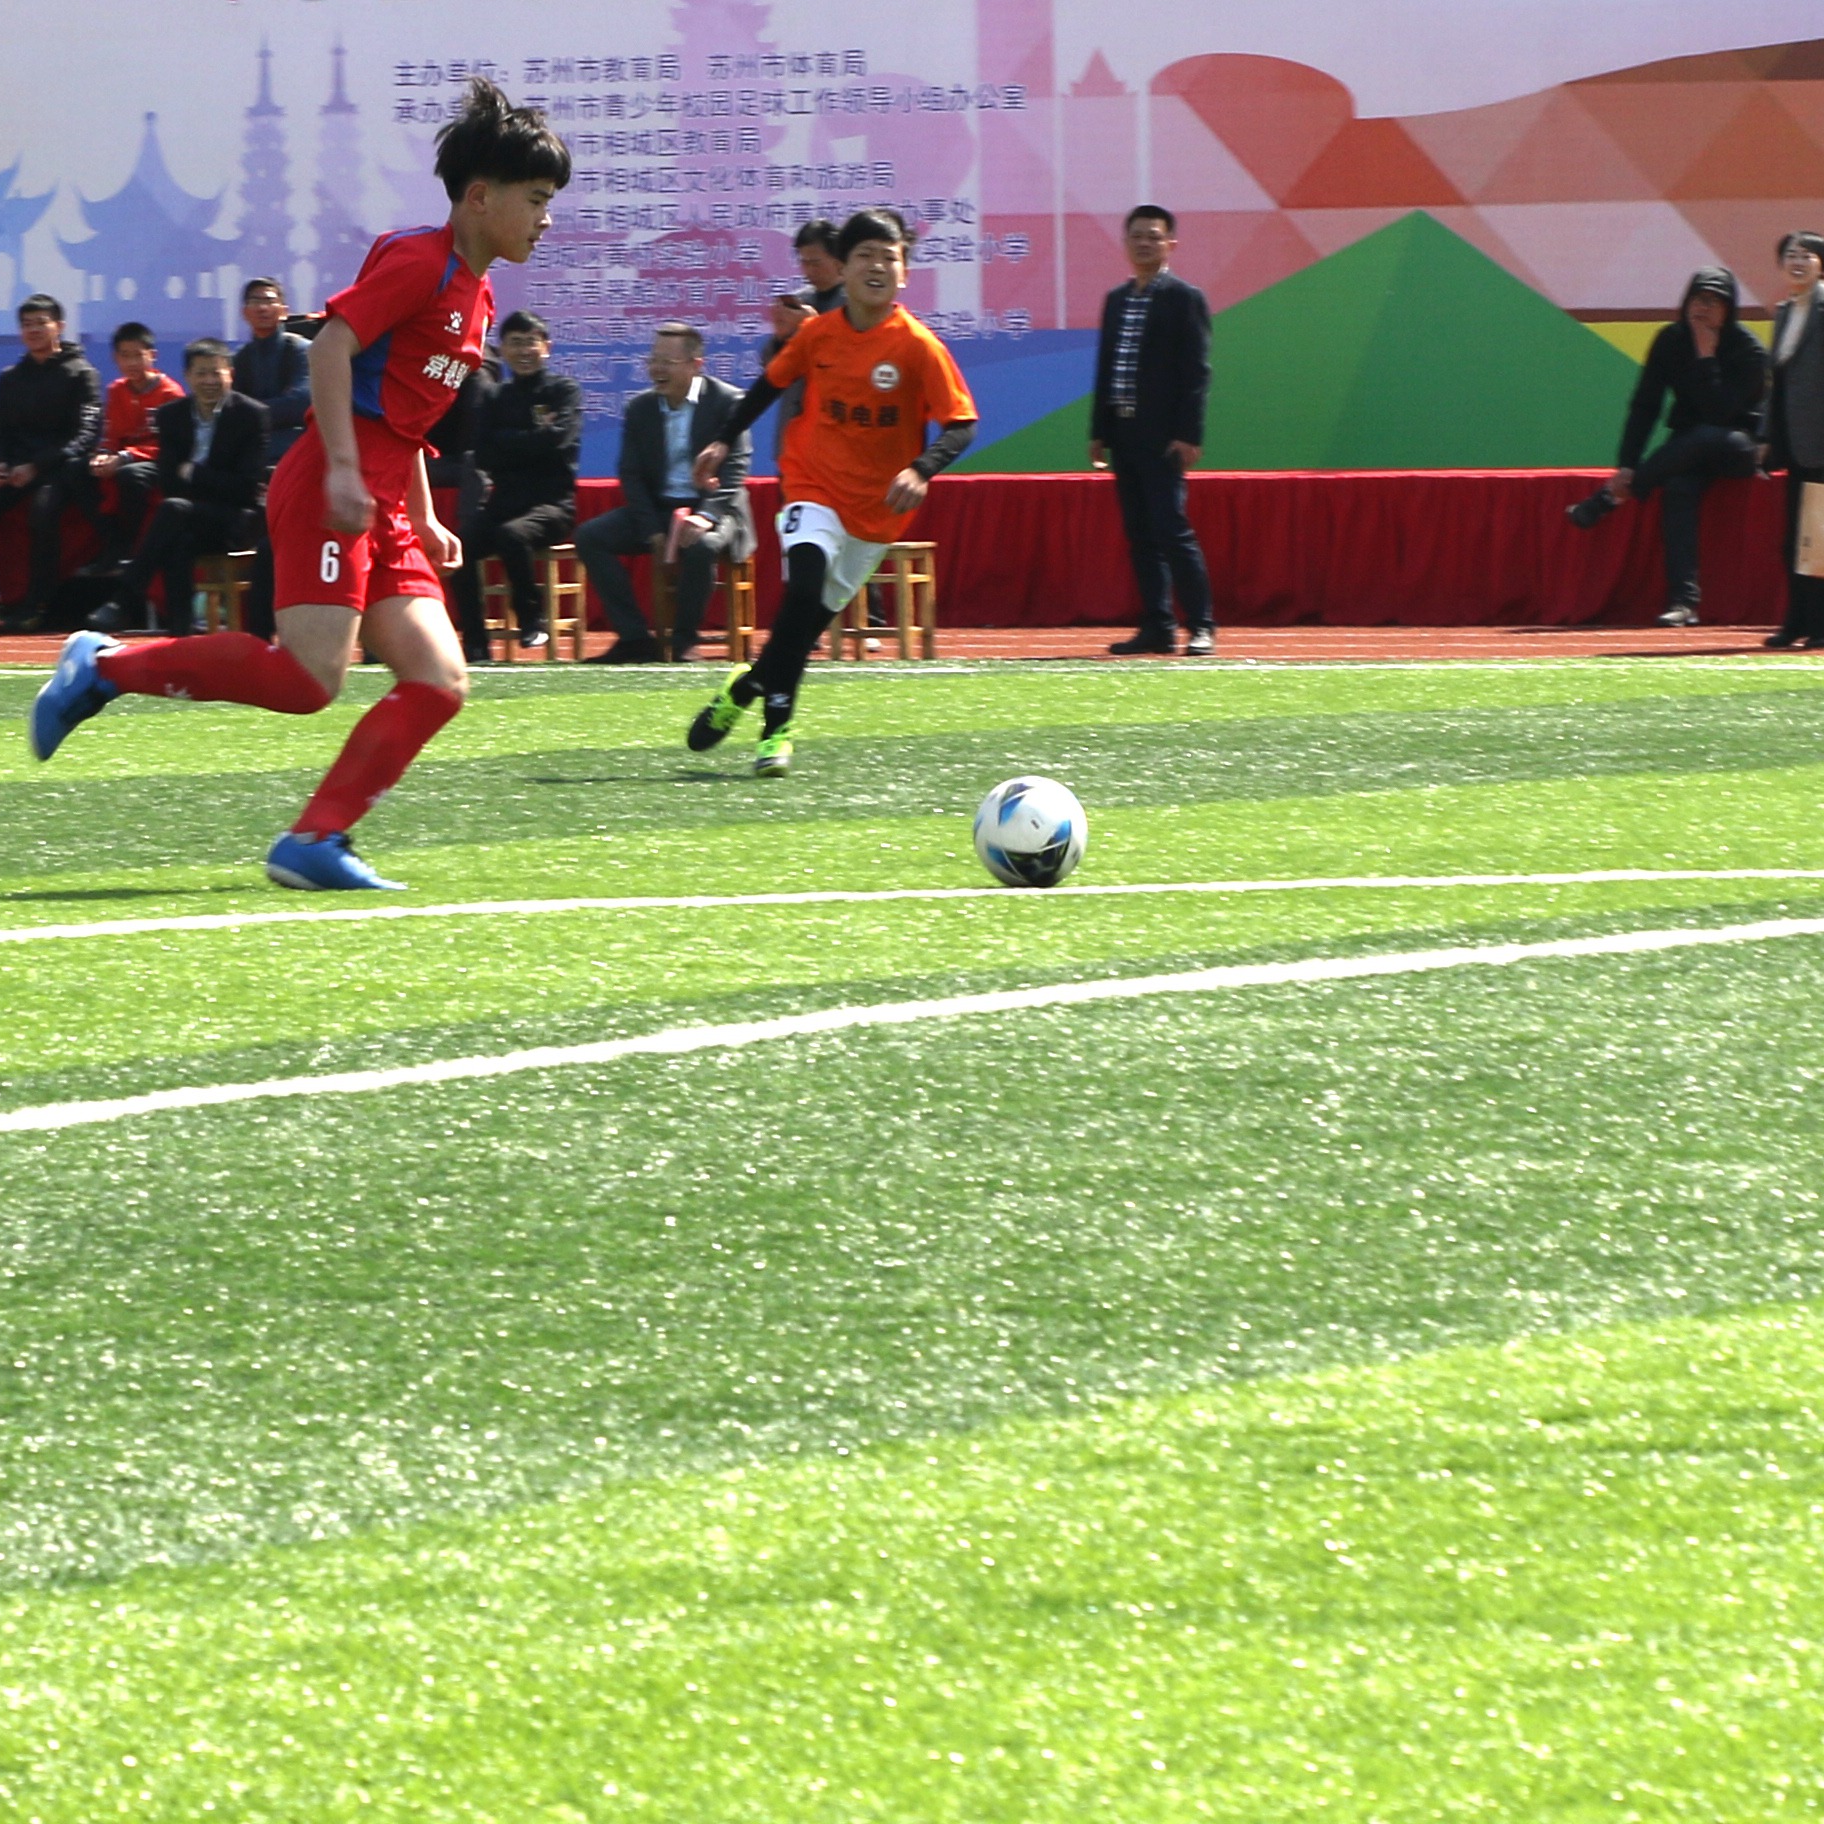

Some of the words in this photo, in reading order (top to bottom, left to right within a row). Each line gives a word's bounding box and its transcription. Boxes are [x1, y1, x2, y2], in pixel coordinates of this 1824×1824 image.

[523, 52, 680, 84] 苏州市教育局
[706, 48, 868, 79] 苏州市体育局
[570, 159, 894, 195] 市相城区文化体育和旅游局
[320, 540, 341, 584] 6
